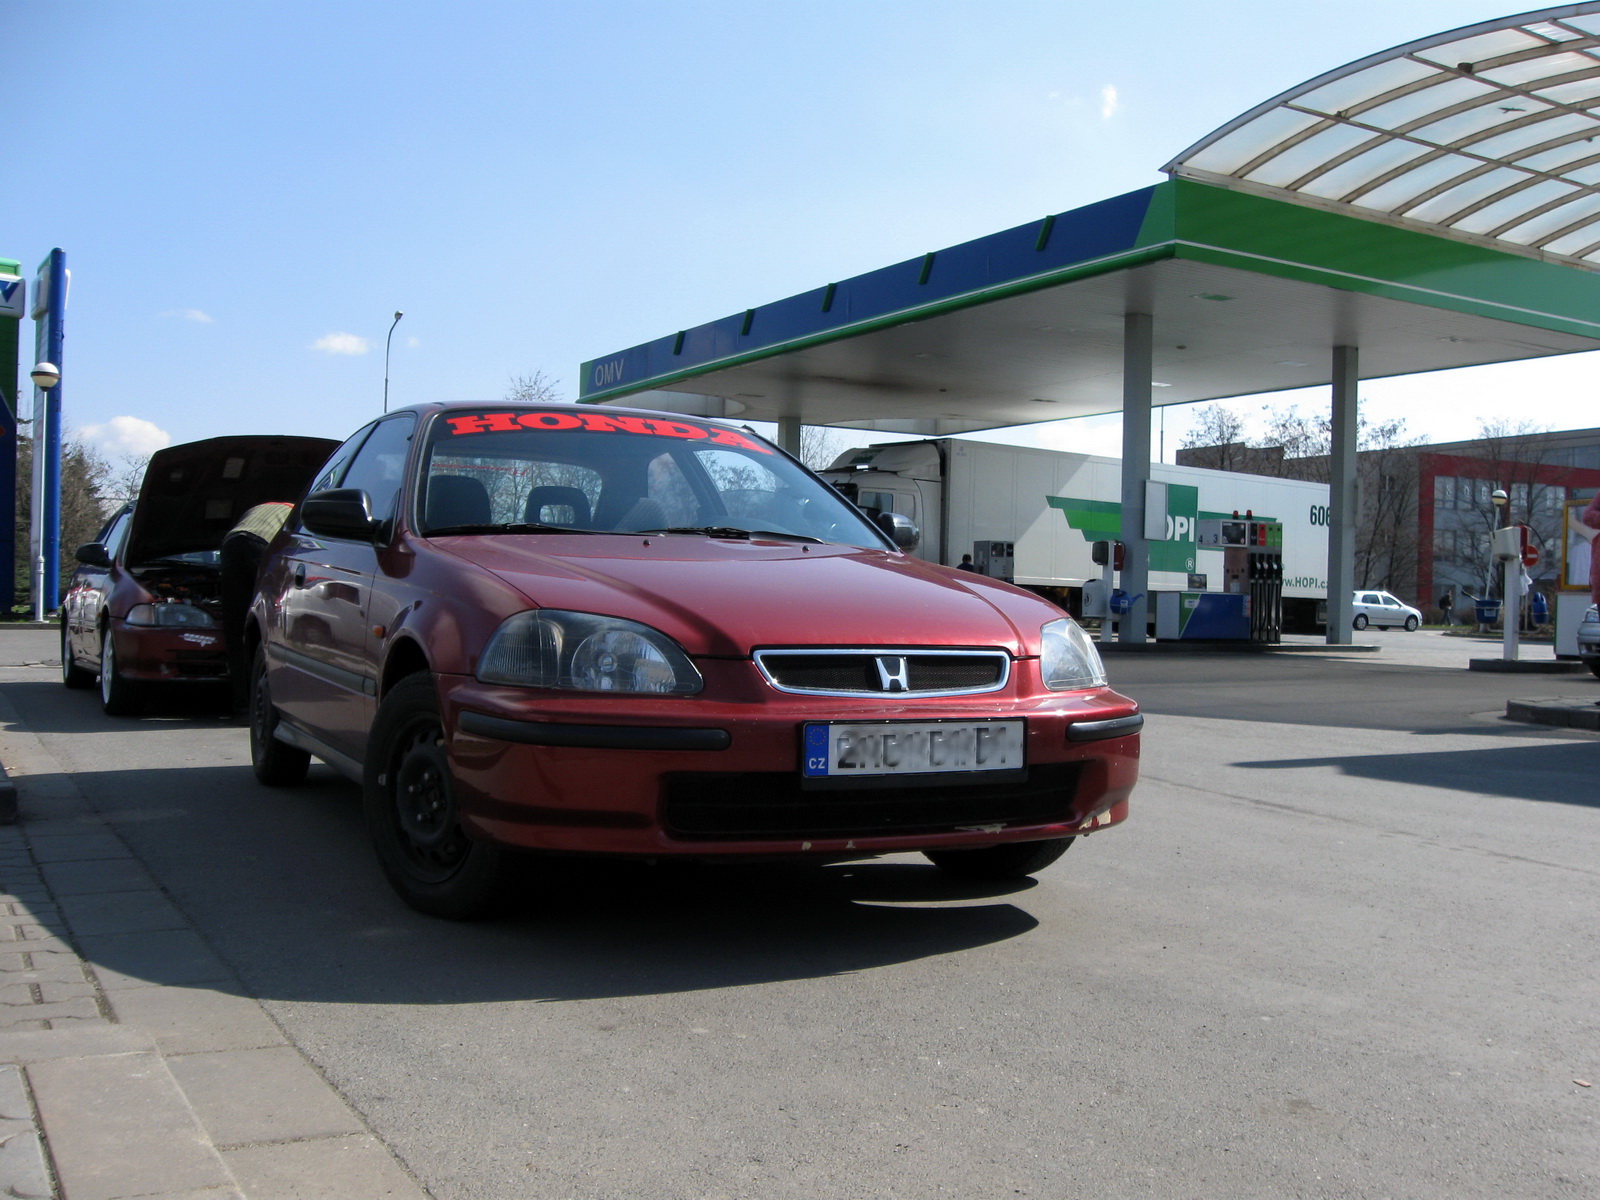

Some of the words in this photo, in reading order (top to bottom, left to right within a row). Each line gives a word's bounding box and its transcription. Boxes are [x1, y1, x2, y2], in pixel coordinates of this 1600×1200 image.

[594, 359, 624, 387] OMV
[446, 412, 774, 455] HONDA
[808, 757, 826, 770] CZ
